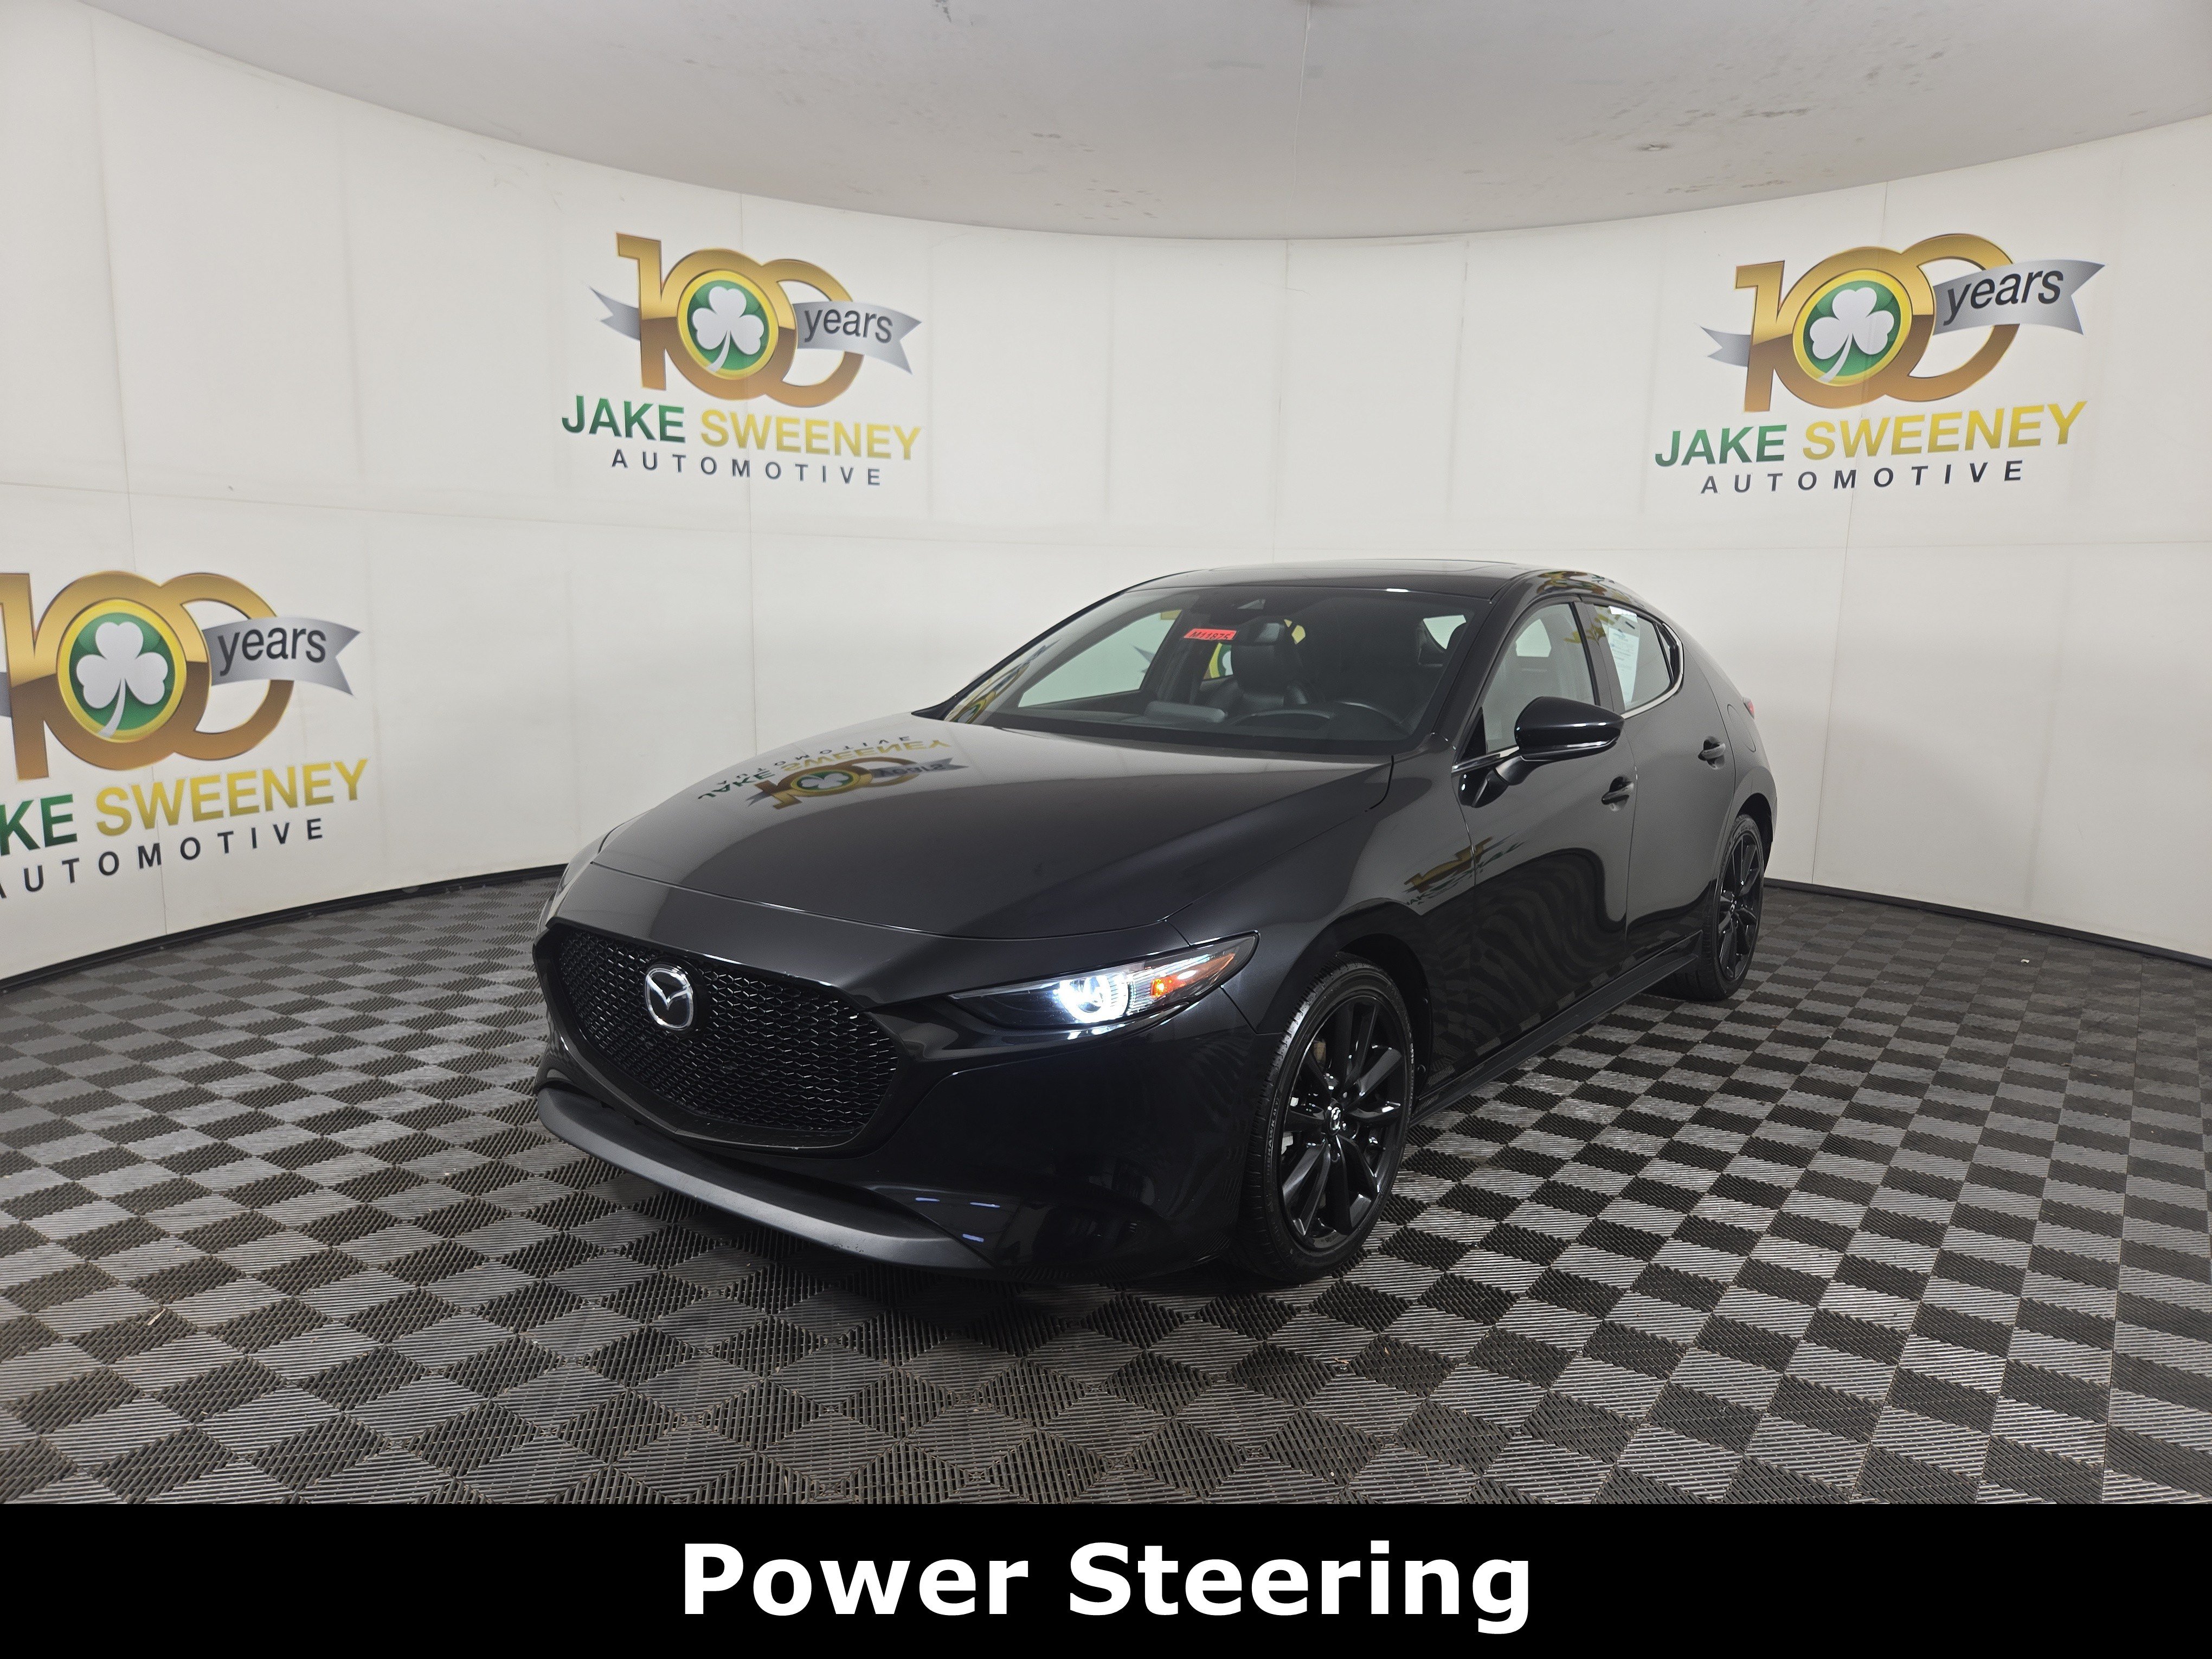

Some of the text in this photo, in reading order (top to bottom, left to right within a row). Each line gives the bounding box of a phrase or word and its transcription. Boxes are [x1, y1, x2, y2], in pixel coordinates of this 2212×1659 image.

[616, 232, 893, 408] 100 years
[1735, 233, 2065, 413] 100 years
[562, 394, 923, 460] JAKE SWEENEY
[1655, 400, 2088, 467] JAKE SWEENEY
[612, 448, 881, 486] AUTOMOTIVE
[1700, 460, 2024, 495] AUTOMOTIVE
[0, 571, 327, 780] 100 years
[95, 758, 369, 837] SWEENEY
[0, 818, 324, 899] UTOMOTIVE
